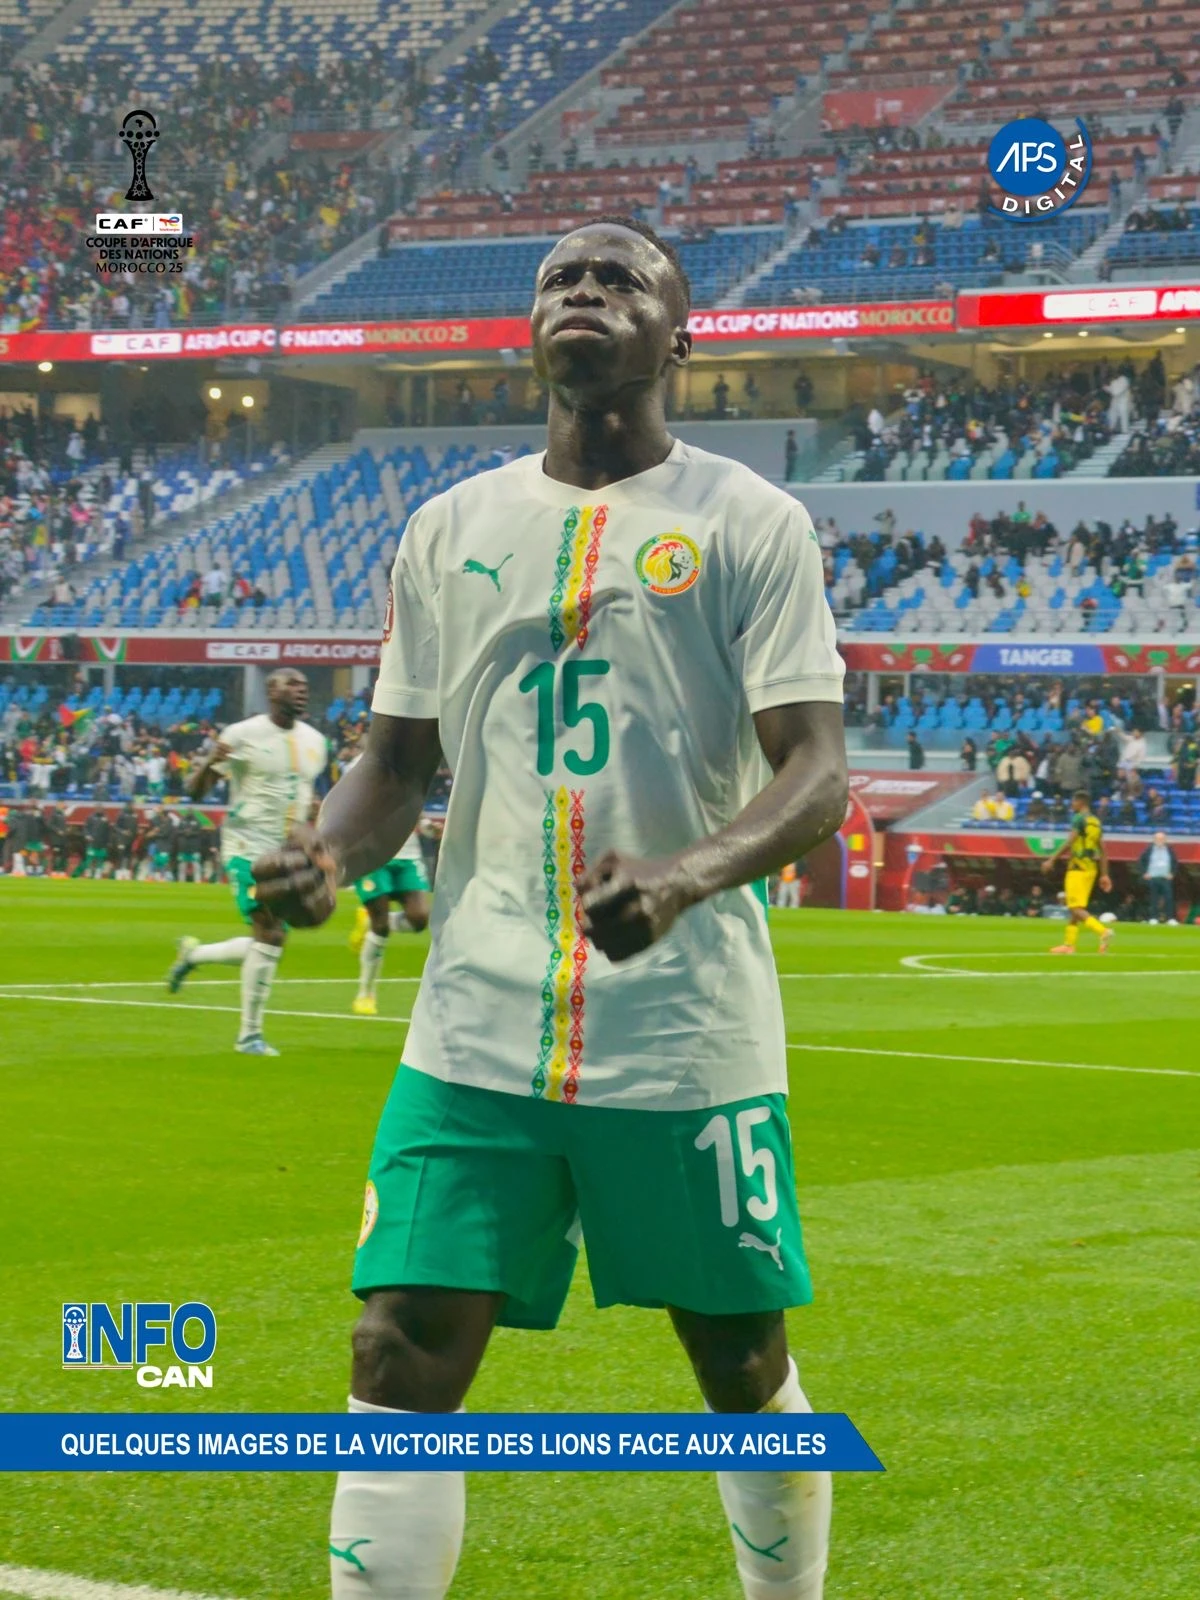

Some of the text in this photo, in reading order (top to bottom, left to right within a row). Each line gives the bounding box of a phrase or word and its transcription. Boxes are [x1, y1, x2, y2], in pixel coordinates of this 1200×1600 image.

[716, 315, 752, 333] CUP
[753, 313, 778, 331] OF
[780, 310, 859, 330] NATIONS
[860, 307, 954, 327] MOROCCO
[126, 337, 170, 350] CAF
[295, 328, 364, 346] NATIONS
[364, 326, 449, 344] MOROCCO
[233, 645, 271, 656] CAF
[283, 643, 330, 657] AFRICA
[331, 644, 357, 658] CUP
[1000, 648, 1074, 666] TANGER
[518, 659, 610, 776] 15
[694, 1105, 778, 1228] 15
